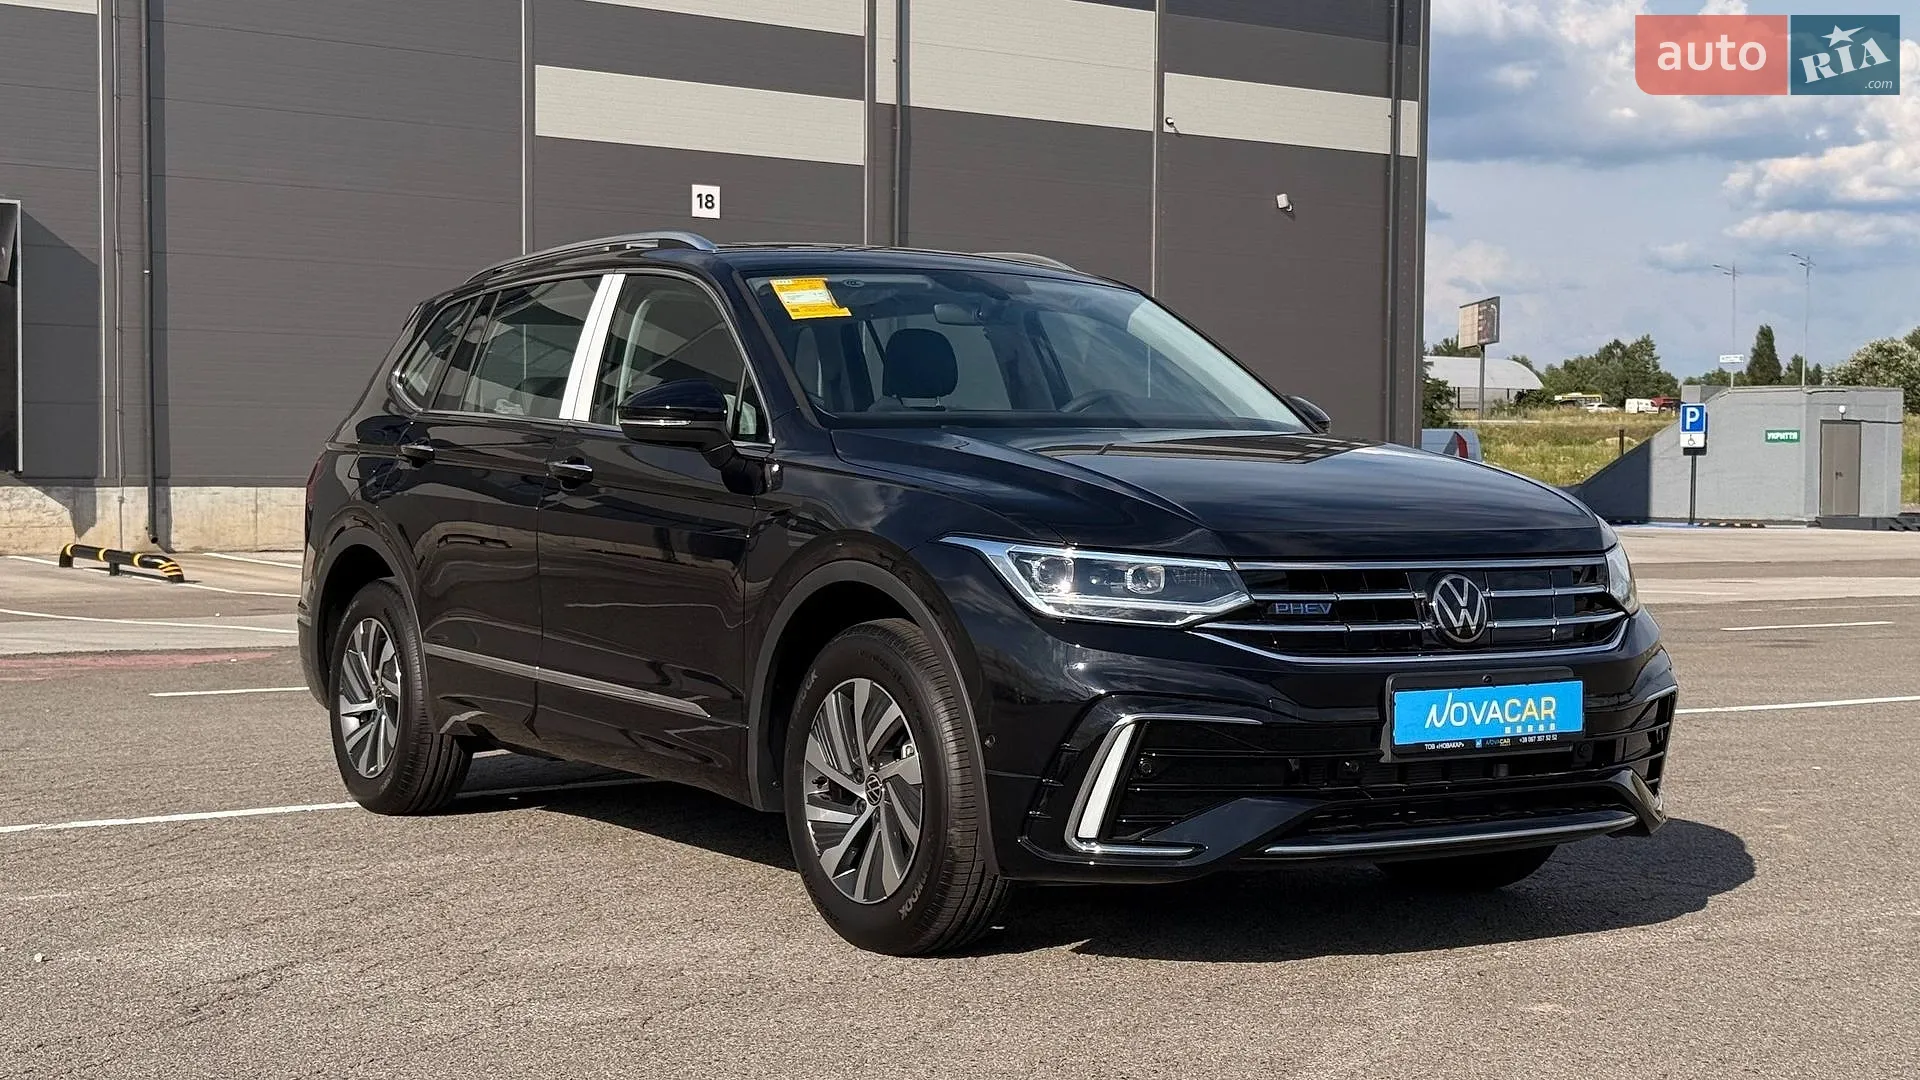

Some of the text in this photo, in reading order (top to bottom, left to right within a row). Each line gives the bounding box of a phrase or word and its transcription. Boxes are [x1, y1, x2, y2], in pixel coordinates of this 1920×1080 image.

[697, 193, 715, 209] 18
[1686, 407, 1700, 430] P
[1767, 432, 1798, 440] УКРИТТЯ
[1275, 602, 1332, 615] PHEV
[1424, 692, 1556, 729] NOVACAR
